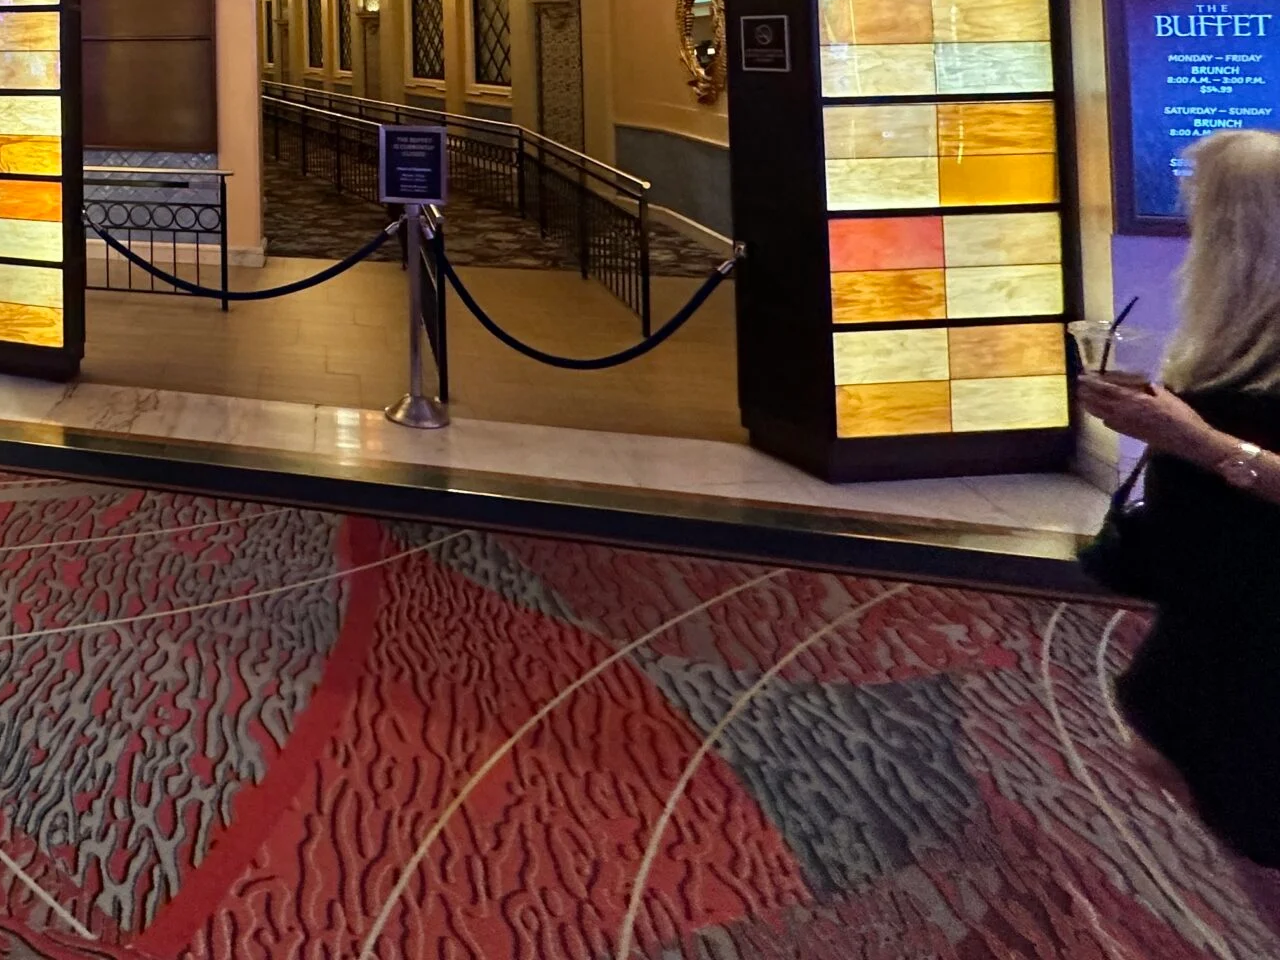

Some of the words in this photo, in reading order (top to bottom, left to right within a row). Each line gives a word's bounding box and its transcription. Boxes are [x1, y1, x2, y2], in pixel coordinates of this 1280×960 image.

[1195, 4, 1229, 13] THE
[1154, 14, 1273, 37] BUFFET
[1167, 54, 1213, 62] MONDAY
[1225, 54, 1263, 62] FRIDAY
[1191, 66, 1240, 75] BRUNCH
[1163, 106, 1217, 115] SATURDAY
[1228, 107, 1273, 116] SUNDAY
[1193, 118, 1242, 128] BRUNCH
